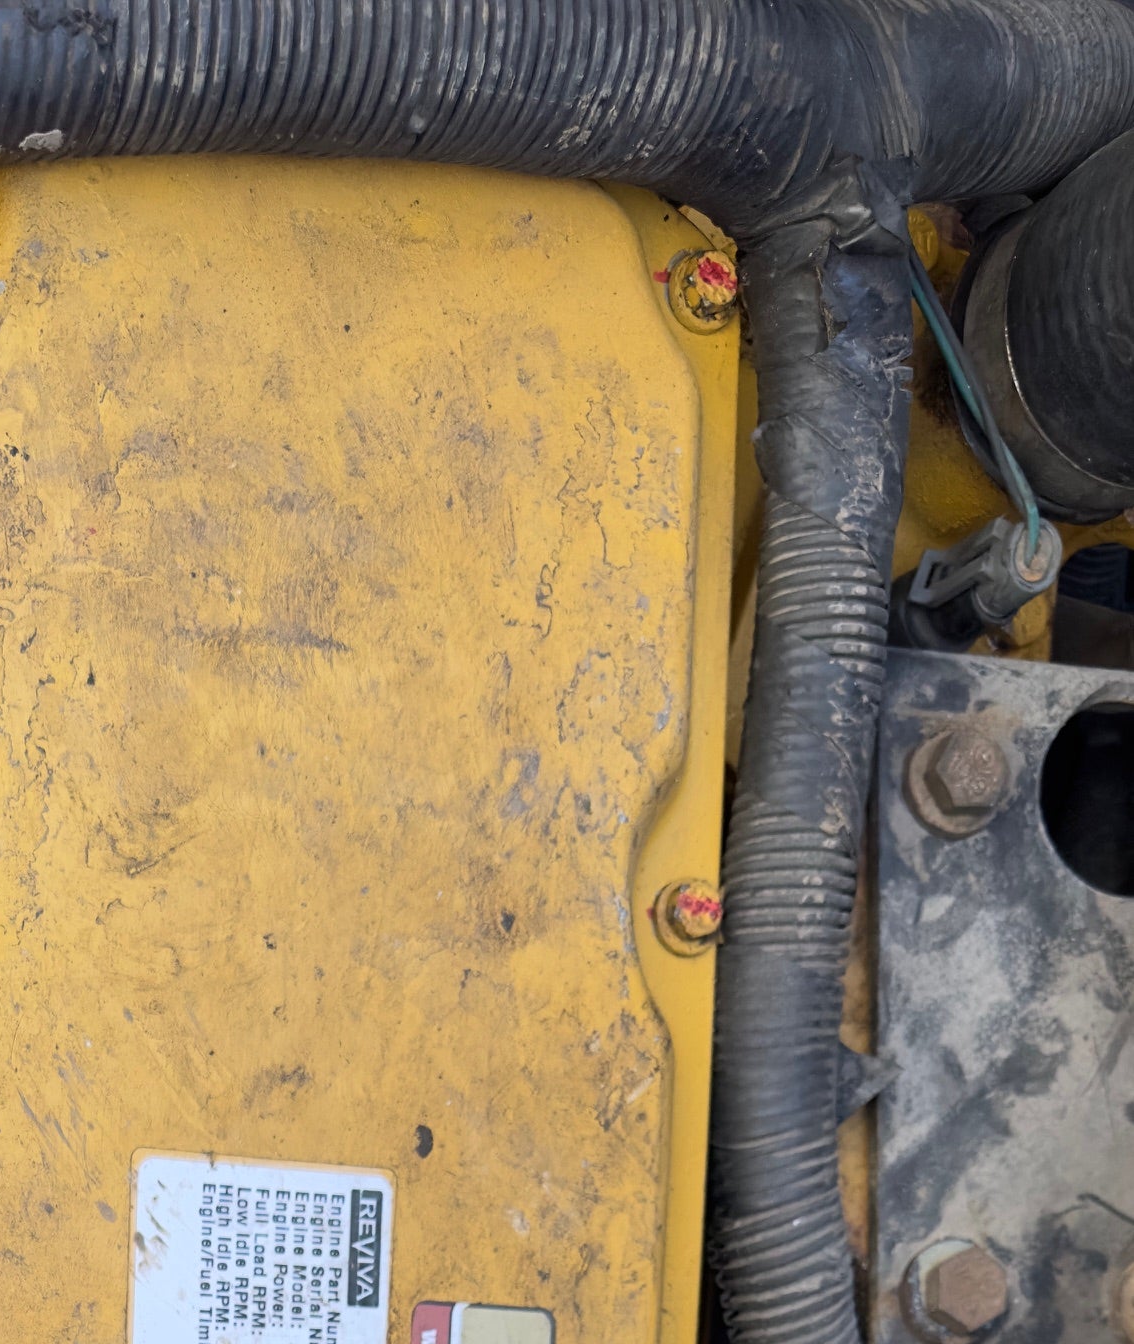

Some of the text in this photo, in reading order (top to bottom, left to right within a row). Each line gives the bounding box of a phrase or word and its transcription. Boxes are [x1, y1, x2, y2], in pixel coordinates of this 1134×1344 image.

[216, 1185, 233, 1227] High
[237, 1188, 251, 1226] Low
[256, 1189, 270, 1223] Full
[272, 1190, 290, 1254] Engine
[292, 1192, 309, 1256] Engine
[310, 1193, 327, 1256] Engine
[328, 1194, 345, 1258] Engine
[199, 1184, 216, 1297] Engine/Fuel
[217, 1237, 232, 1271] Idle
[236, 1234, 250, 1267] Idle
[254, 1234, 268, 1277] Load
[352, 1198, 377, 1301] REVIVA
[215, 1281, 230, 1330] RPM:
[234, 1277, 249, 1326] RPM:
[272, 1264, 288, 1327] Power:
[291, 1265, 307, 1328] Model:
[310, 1266, 324, 1318] Serial
[328, 1267, 342, 1303] Part
[252, 1286, 266, 1335] RPM:
